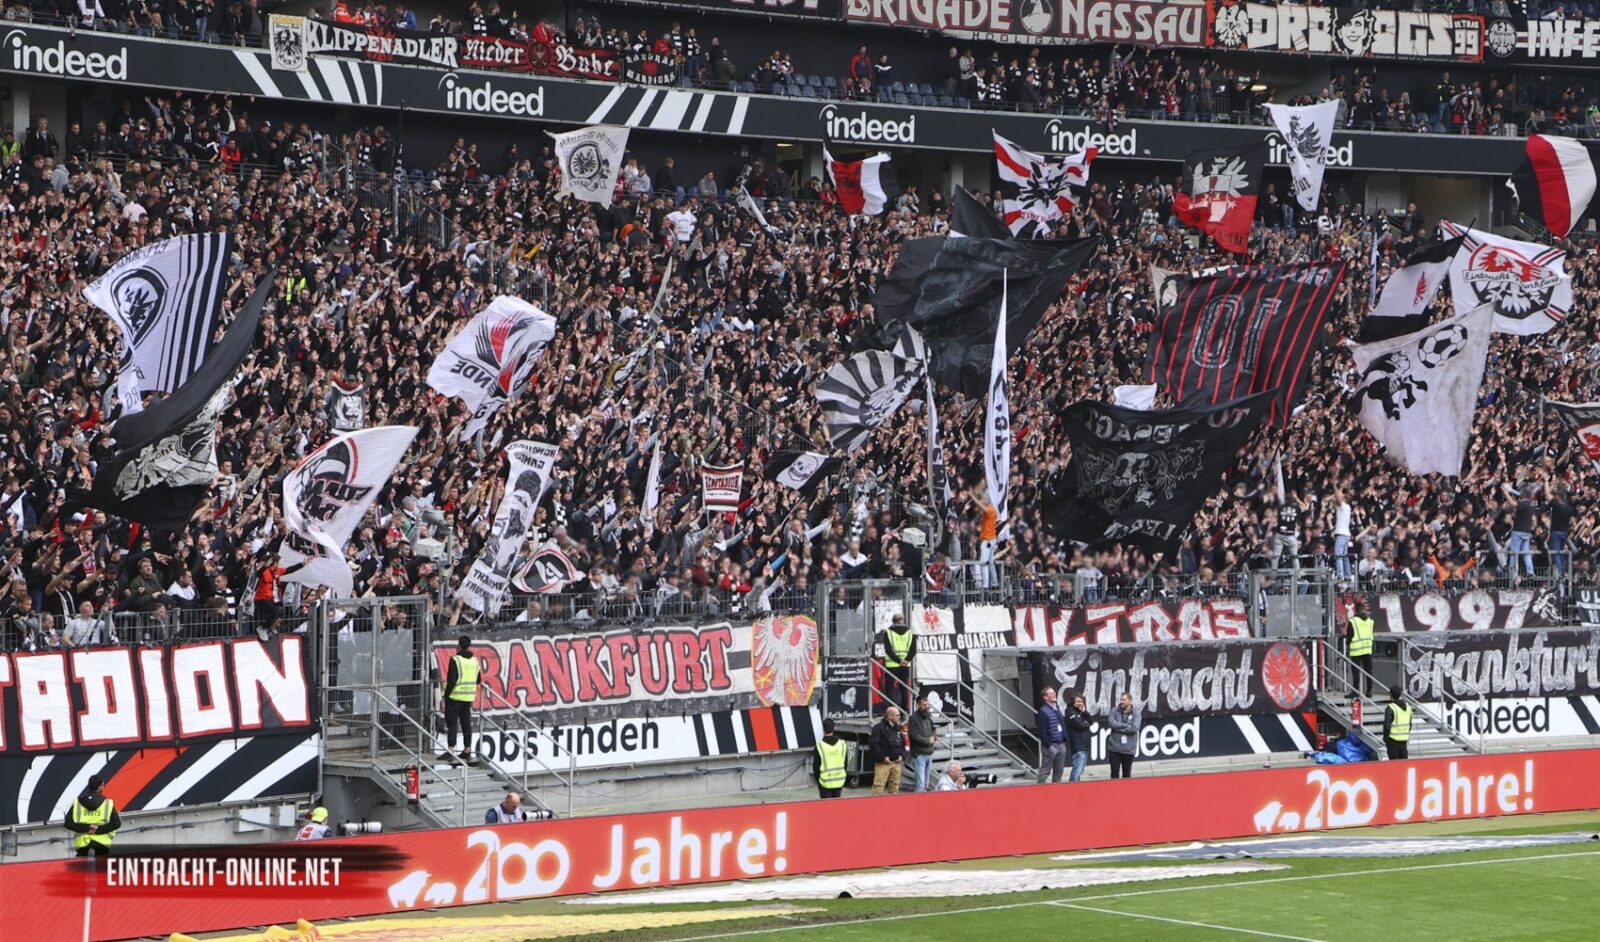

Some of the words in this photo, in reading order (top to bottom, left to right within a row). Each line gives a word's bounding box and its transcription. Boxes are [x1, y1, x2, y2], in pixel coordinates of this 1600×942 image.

[306, 18, 459, 68] KLIPPENADLER
[847, 0, 1012, 31] BRIGADE
[1060, 0, 1204, 45] NASSAU
[972, 31, 1085, 45] HOOLIGANS
[1454, 29, 1480, 55] 99
[12, 36, 127, 81] indeed
[446, 80, 544, 116] indeed
[826, 110, 915, 143] indeed
[1051, 125, 1137, 156] indeed
[1268, 135, 1353, 166] ined
[1014, 600, 1251, 646] ULTRAS
[1378, 590, 1535, 633] 1997
[956, 632, 1009, 650] GUARDIA
[1051, 648, 1256, 716] Eintracht
[1404, 630, 1600, 700] Frankfurt
[0, 634, 311, 751] ADION
[475, 724, 538, 762] obs
[551, 716, 659, 757] finden
[1090, 716, 1200, 761] ineed
[1446, 698, 1550, 736] indeed
[1304, 769, 1380, 829] 200
[1393, 759, 1535, 820] Jahre!
[462, 830, 570, 903] 200
[592, 811, 788, 889] Jahre!
